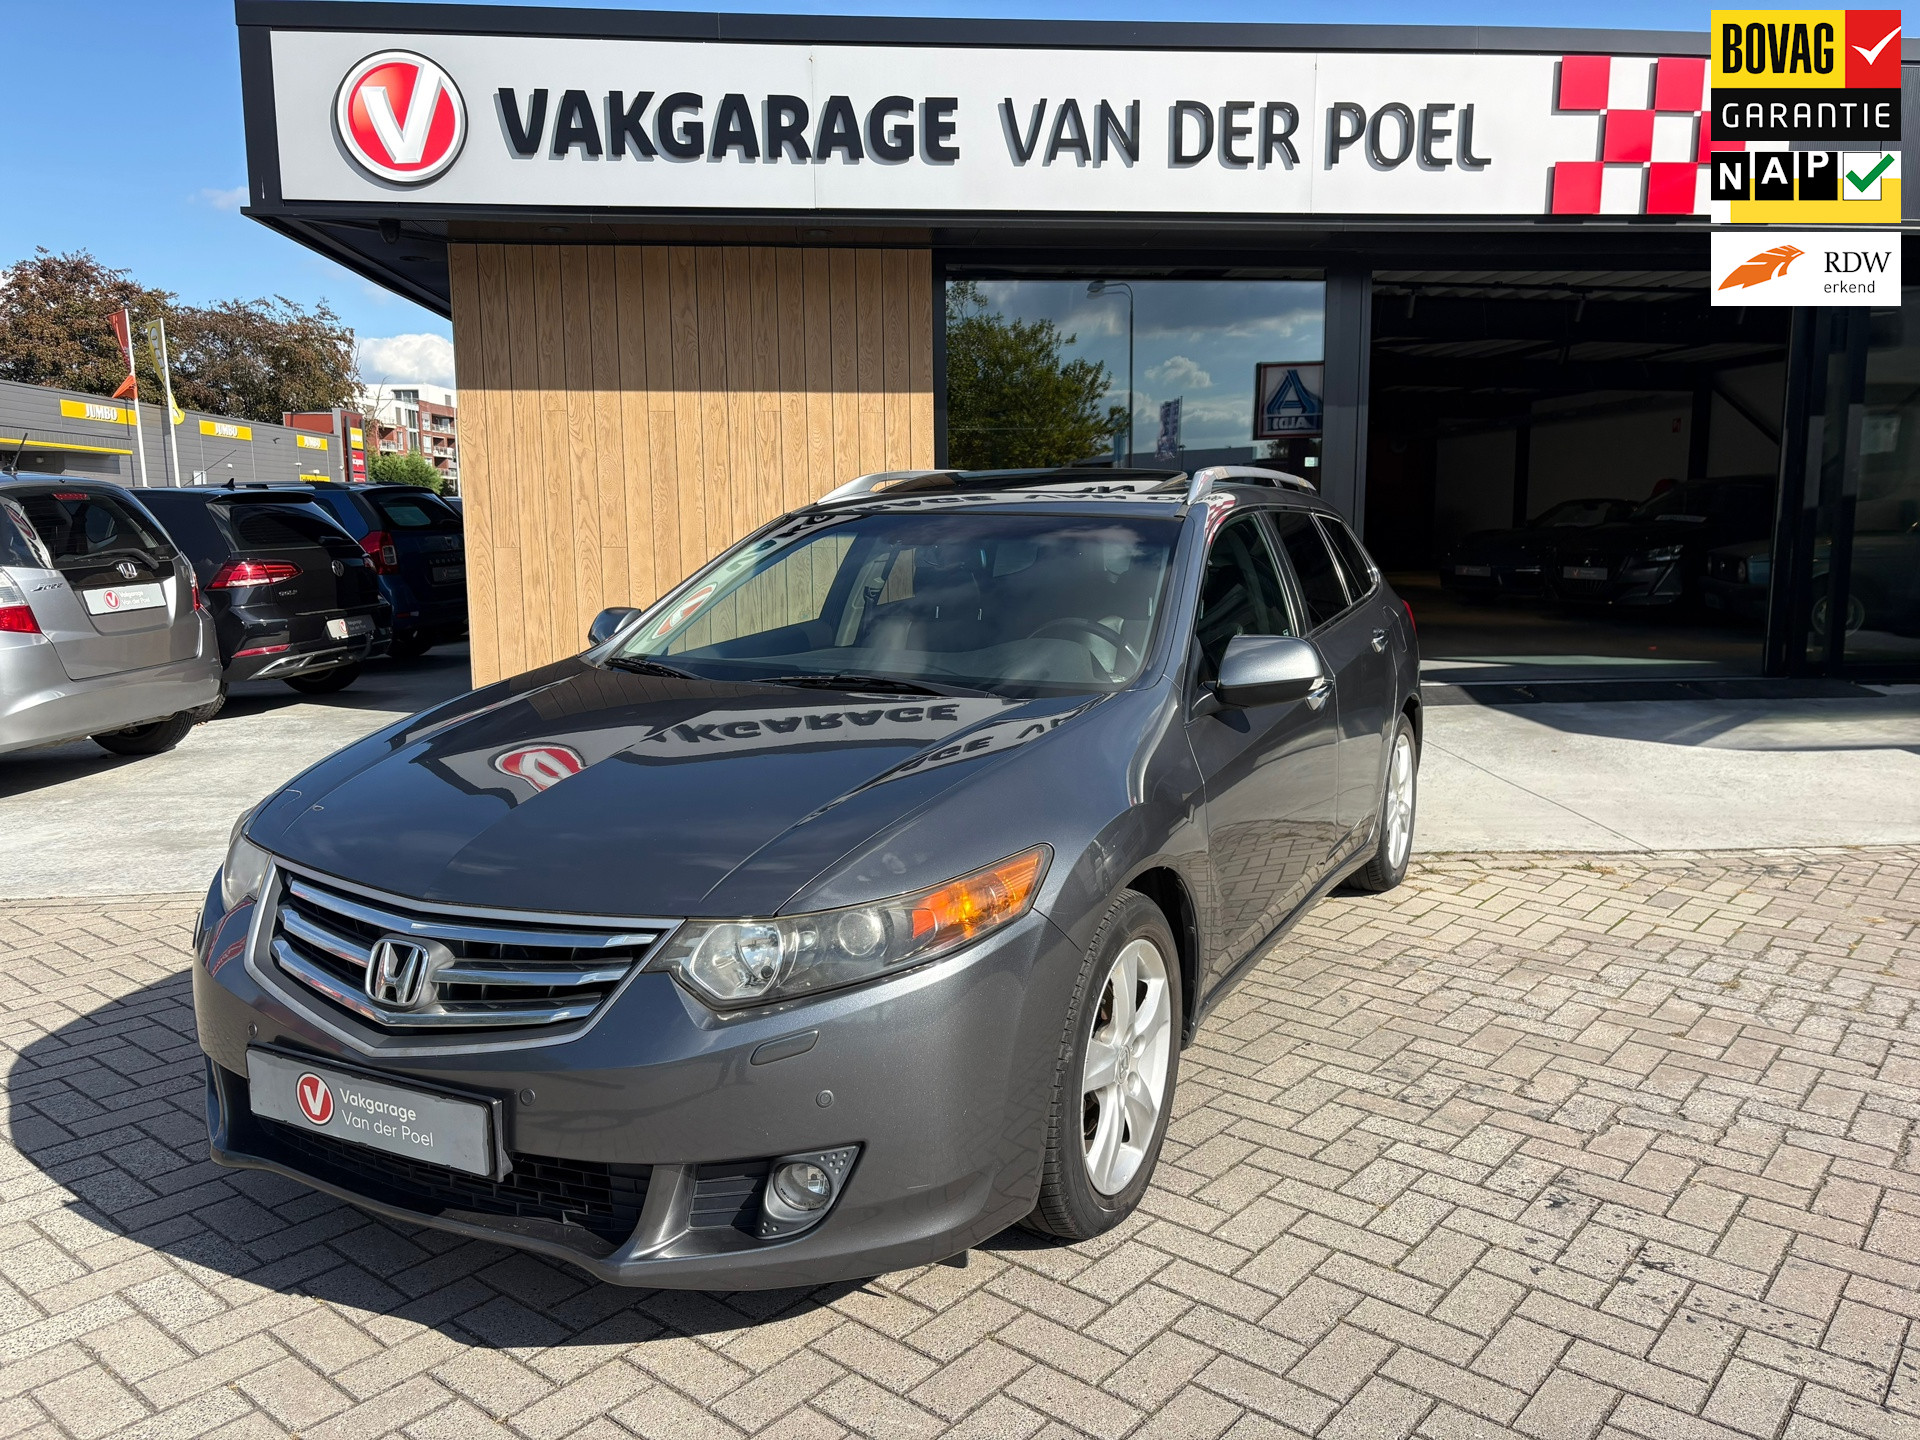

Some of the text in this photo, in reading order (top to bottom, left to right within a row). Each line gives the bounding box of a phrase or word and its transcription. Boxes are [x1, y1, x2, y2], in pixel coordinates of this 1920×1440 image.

[496, 87, 1492, 168] VAKGARAGE VAN DER POEL
[85, 403, 118, 421] JUMBO
[215, 424, 238, 437] JUMBO
[340, 1088, 416, 1122] Vakgarage
[342, 1109, 434, 1148] Van der Poel
